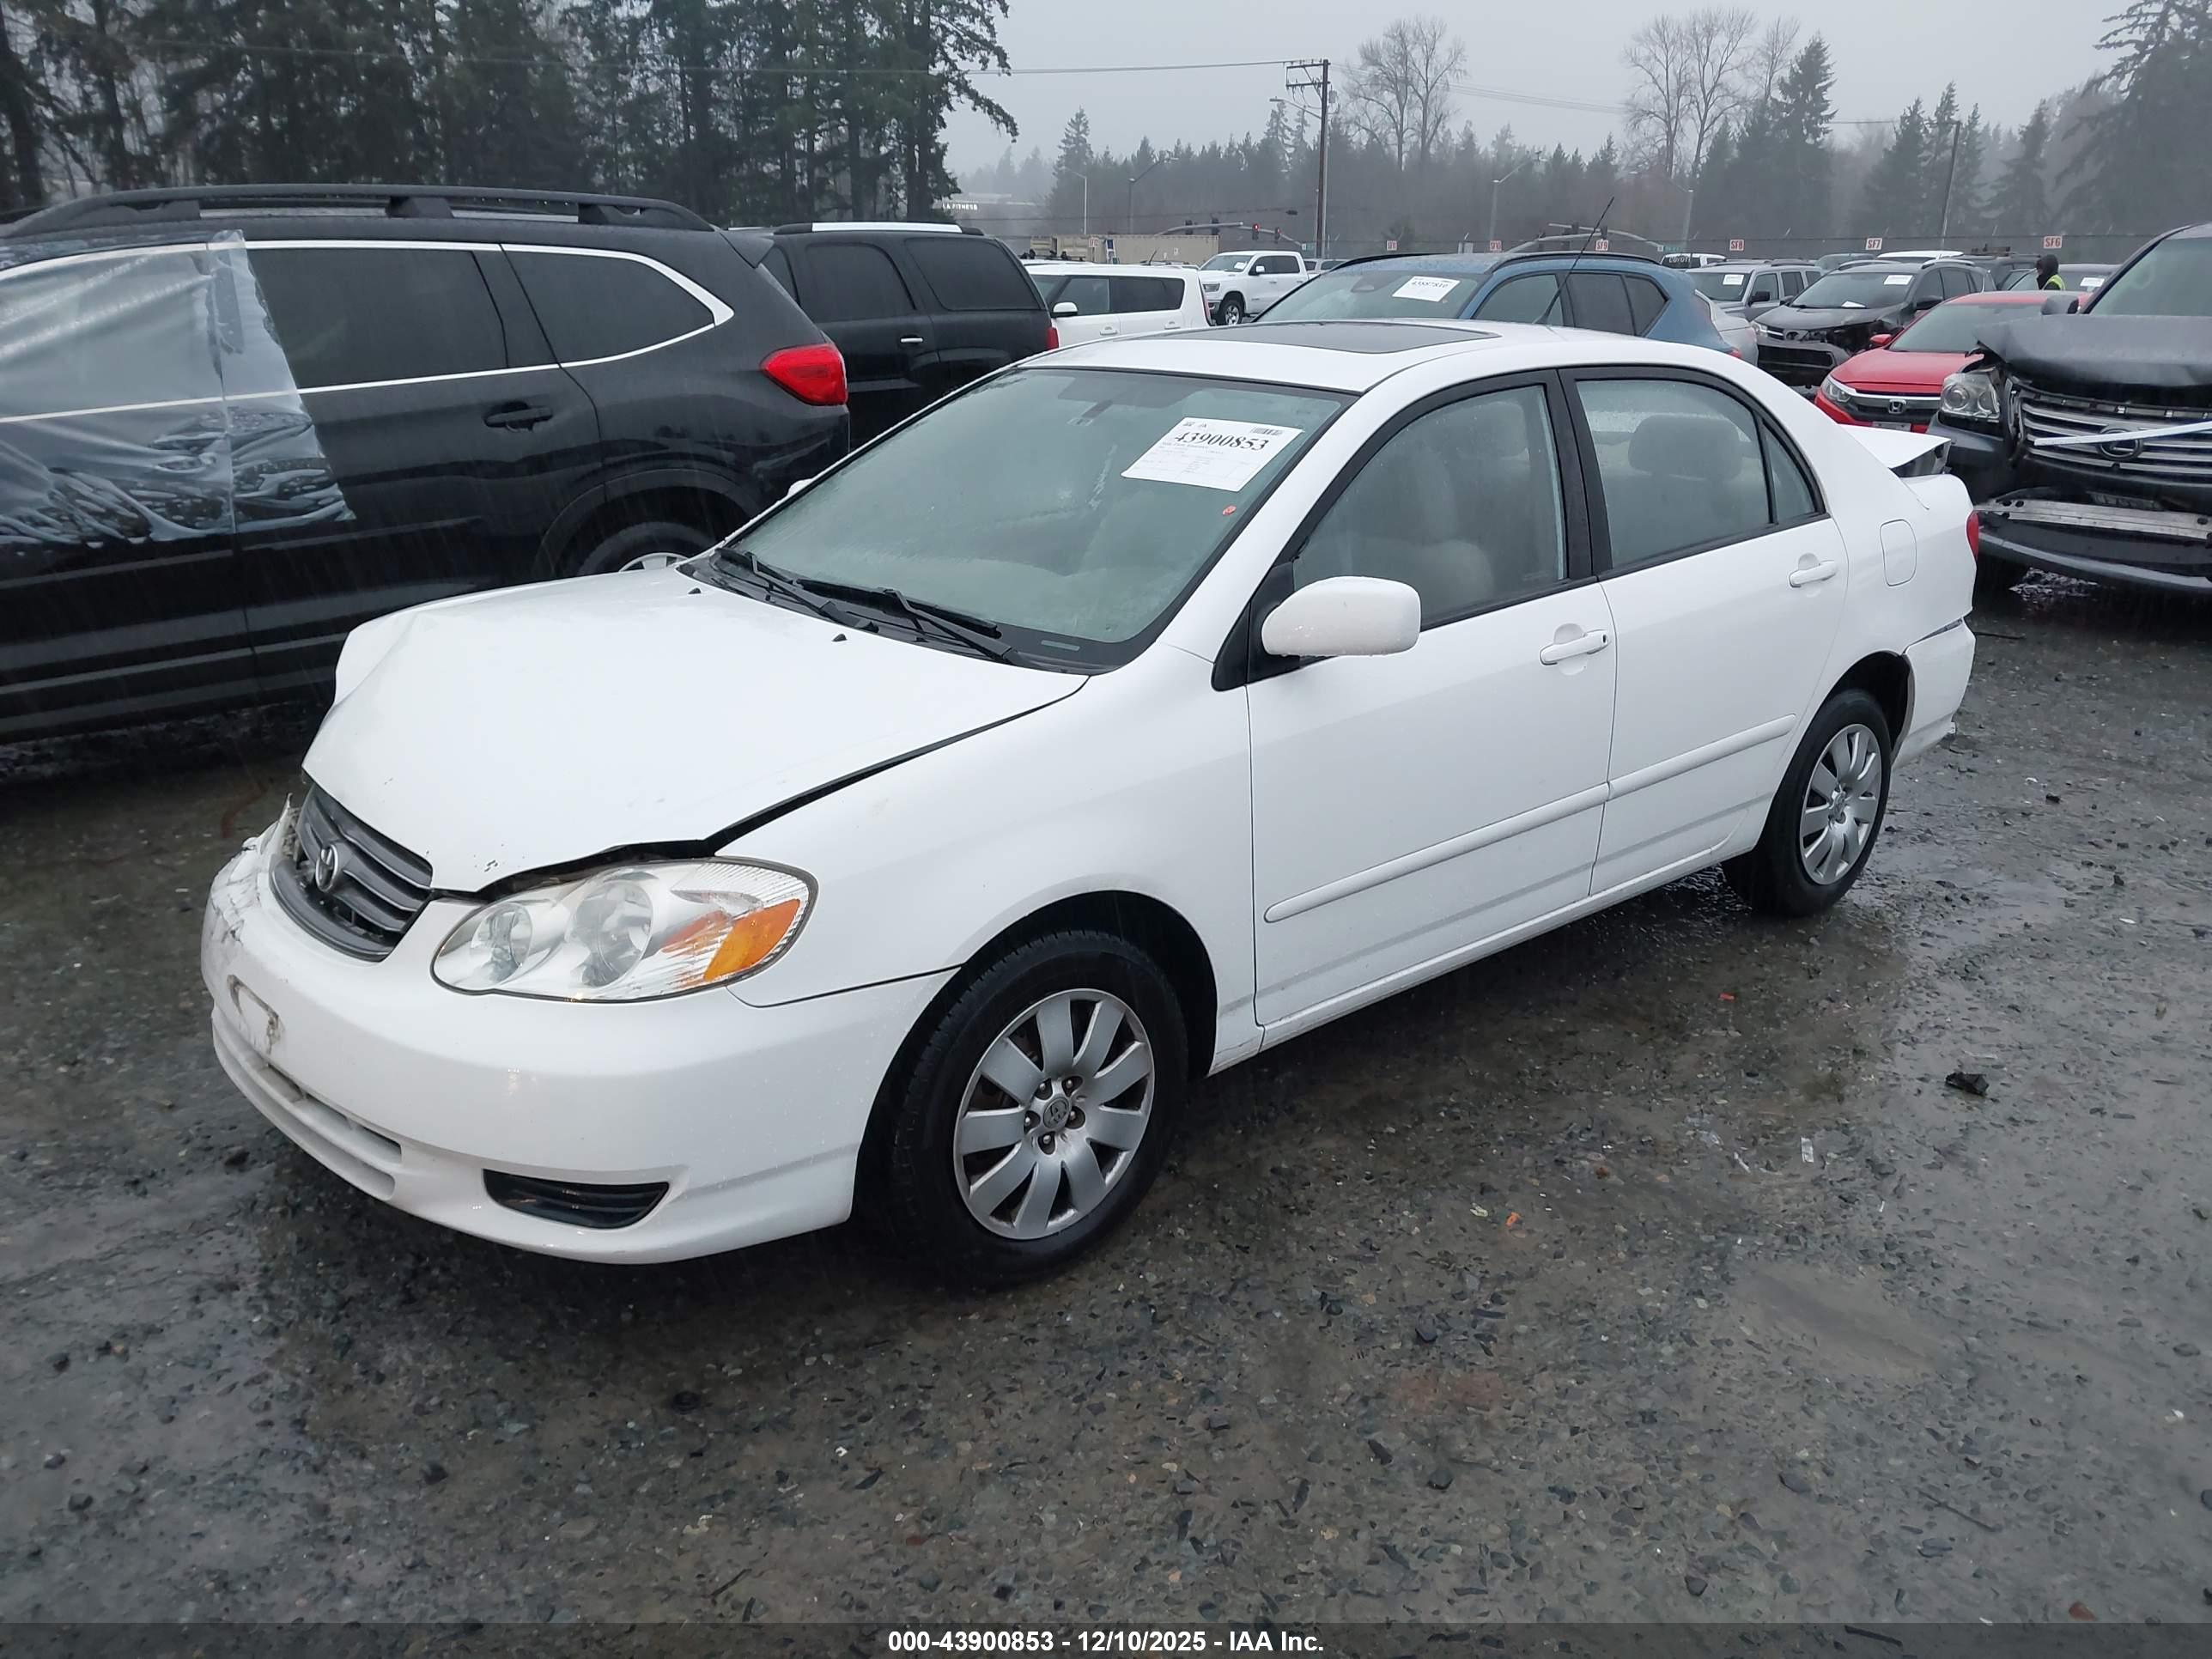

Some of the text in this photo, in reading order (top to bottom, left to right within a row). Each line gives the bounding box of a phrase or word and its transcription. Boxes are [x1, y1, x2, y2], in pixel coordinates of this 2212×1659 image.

[1867, 240, 1881, 249] SF7
[2045, 237, 2061, 247] SF6
[1175, 431, 1270, 452] 43900853
